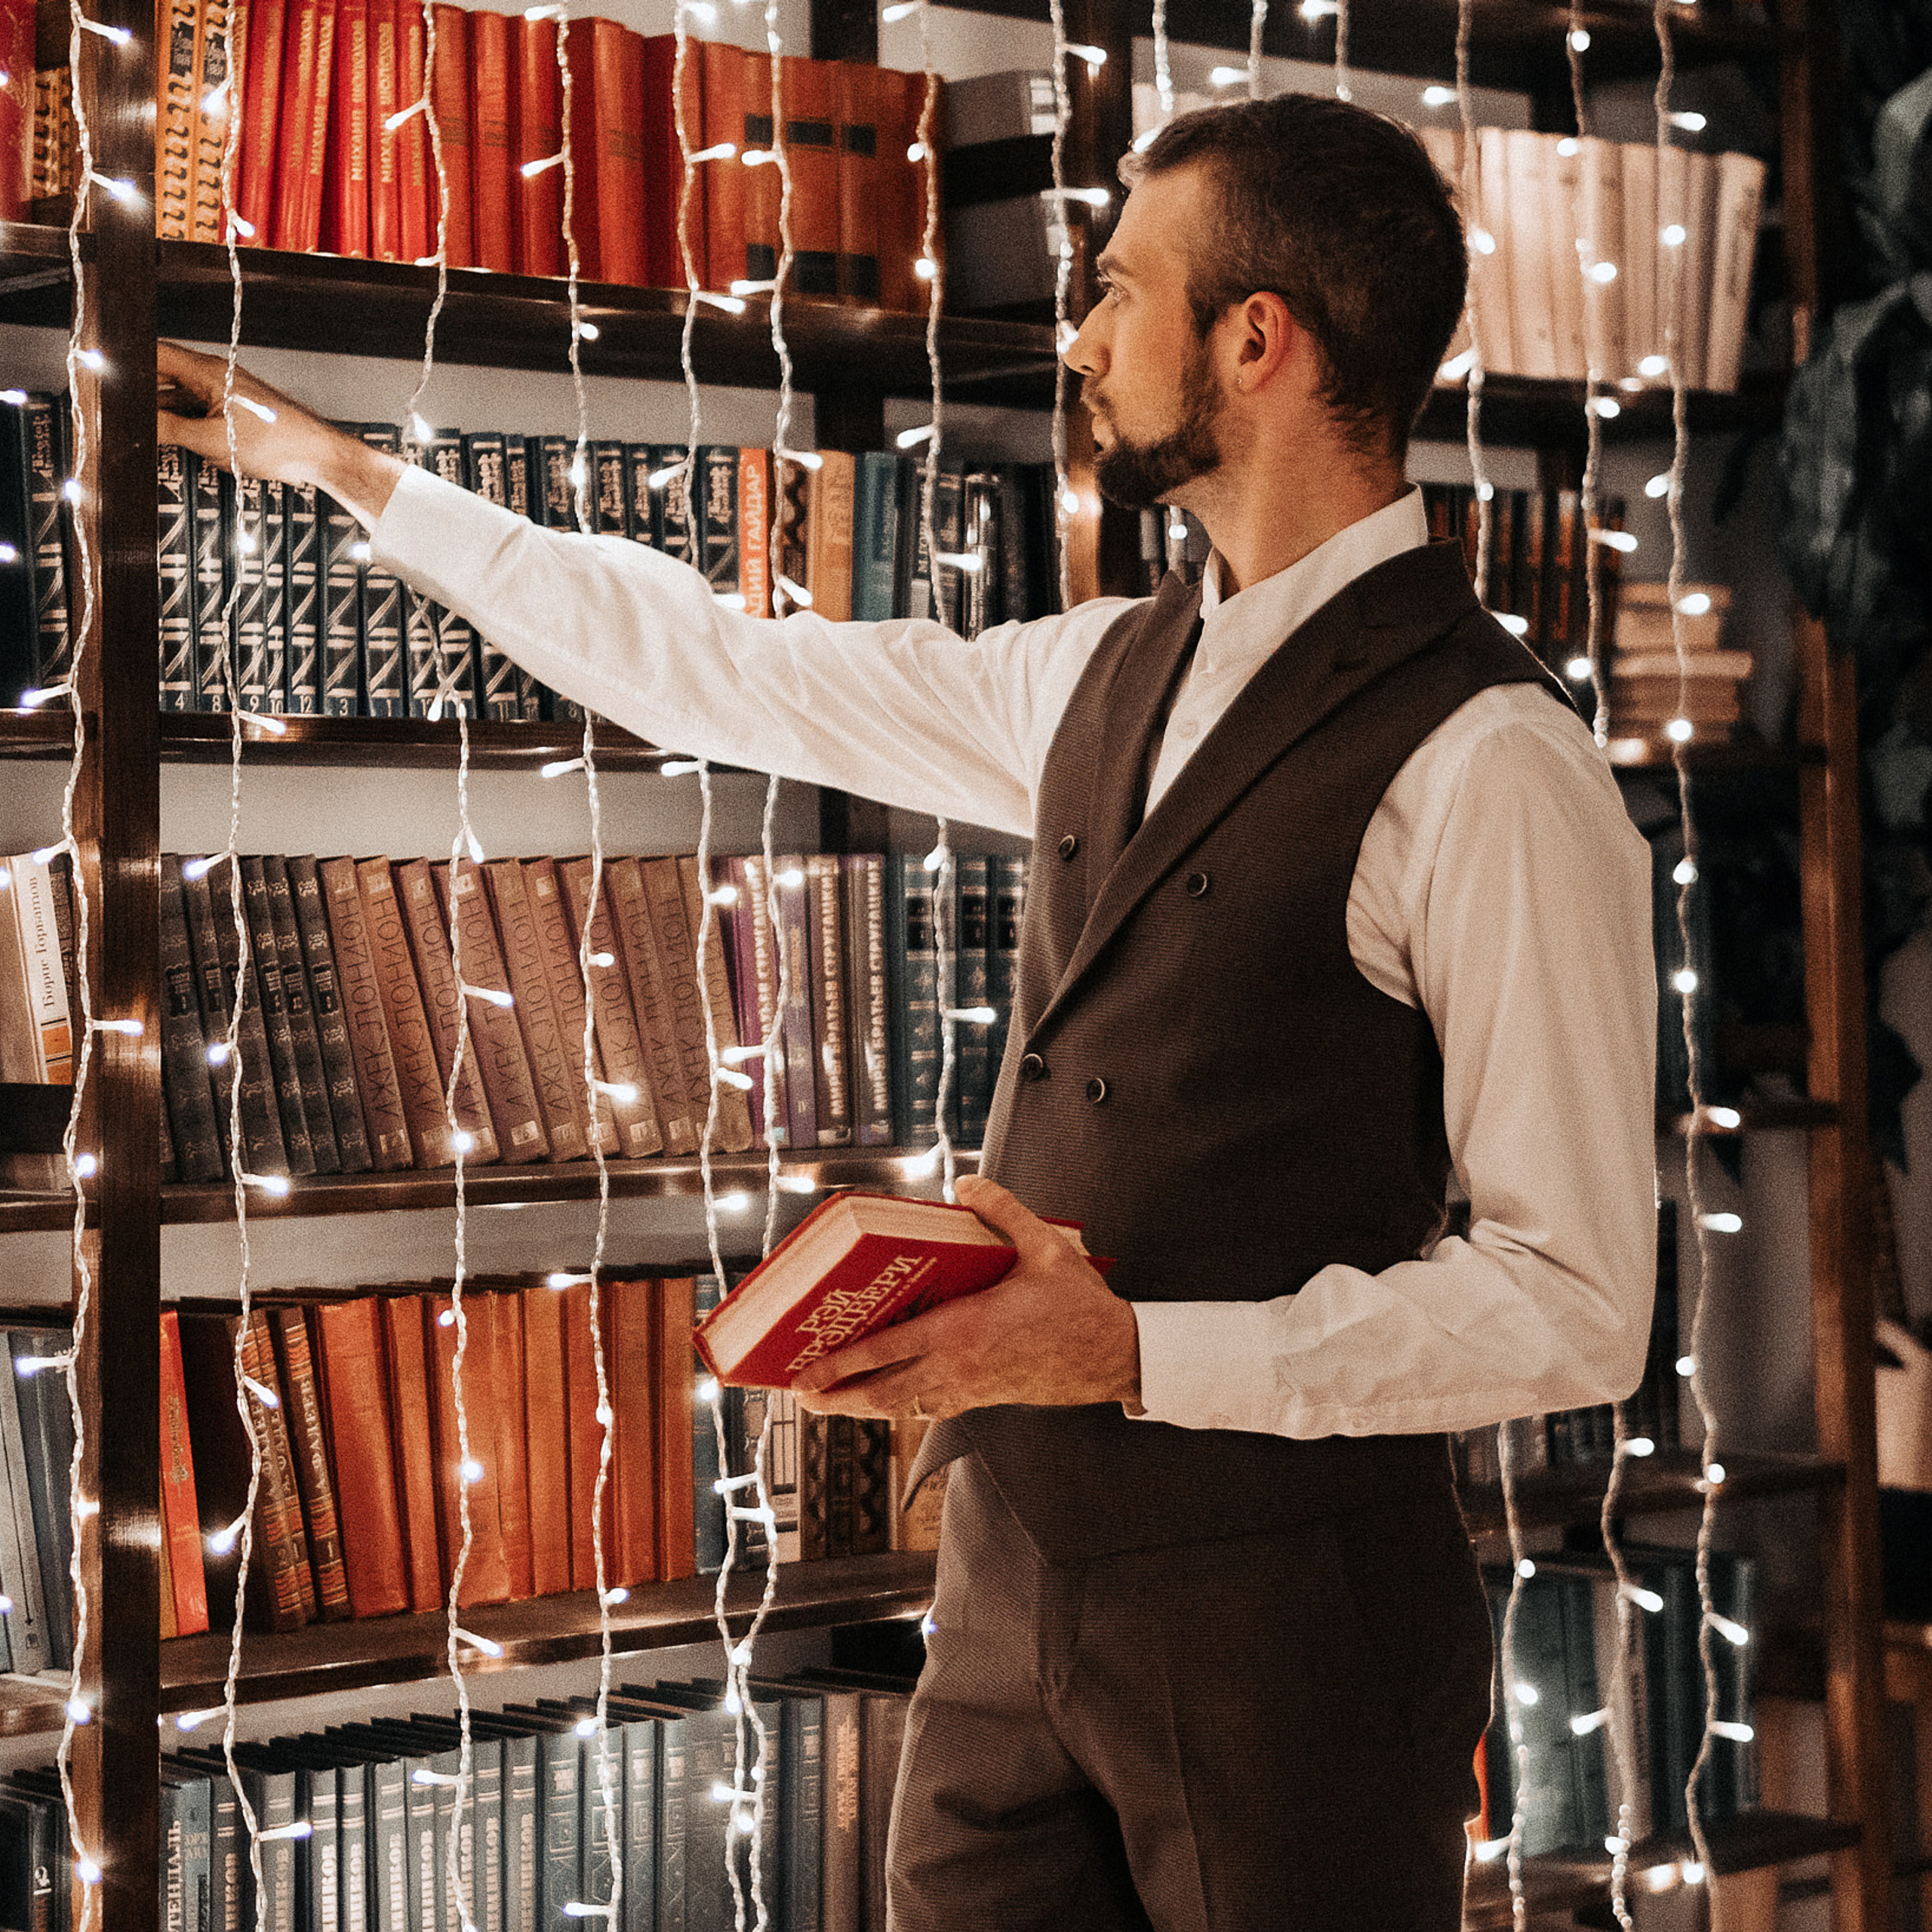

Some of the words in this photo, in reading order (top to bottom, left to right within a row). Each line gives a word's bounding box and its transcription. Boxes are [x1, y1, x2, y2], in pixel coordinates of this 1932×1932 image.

[315, 14, 335, 98] ШОЛОХОВ
[351, 20, 365, 103] ШОЛОХОВ
[379, 22, 393, 106] ШОЛОХОВ
[309, 104, 326, 176] МИХАИЛ
[351, 110, 364, 181] МИХАИЛ
[744, 464, 762, 552] ГАЙДАР
[174, 692, 185, 710] 4
[212, 694, 221, 712] 8
[249, 695, 260, 713] 9
[271, 699, 284, 714] 10
[300, 694, 312, 713] 12
[339, 697, 349, 716] 3
[29, 877, 48, 954] Горбатов
[820, 866, 838, 977] СТРУГАЦКИХ
[867, 860, 882, 971] СТРУГАЦКИХ
[42, 958, 55, 1008] Борис
[337, 896, 383, 1030] ЛОНДОН
[373, 895, 421, 1030] ЛОНДОН
[416, 902, 459, 1031] ЛОНДОН
[509, 900, 553, 1029] ЛОНДОН
[540, 900, 586, 1029] ЛОНДОН
[758, 981, 774, 1046] РАТЬЕВ
[825, 980, 841, 1053] БРАТЬЕВ
[869, 975, 885, 1050] БРАТЬЕВ
[362, 1035, 399, 1118] ДЖЕК
[400, 1037, 443, 1116] ДЖЕК
[535, 1032, 572, 1114] ДЖЕК
[870, 1054, 888, 1110] МИРЫ
[795, 1288, 862, 1334] РЭЙ
[300, 1379, 322, 1469] ФАДЕЕВ
[315, 1472, 327, 1492] А.
[167, 1820, 182, 1932] ТЕНДАЛЬ
